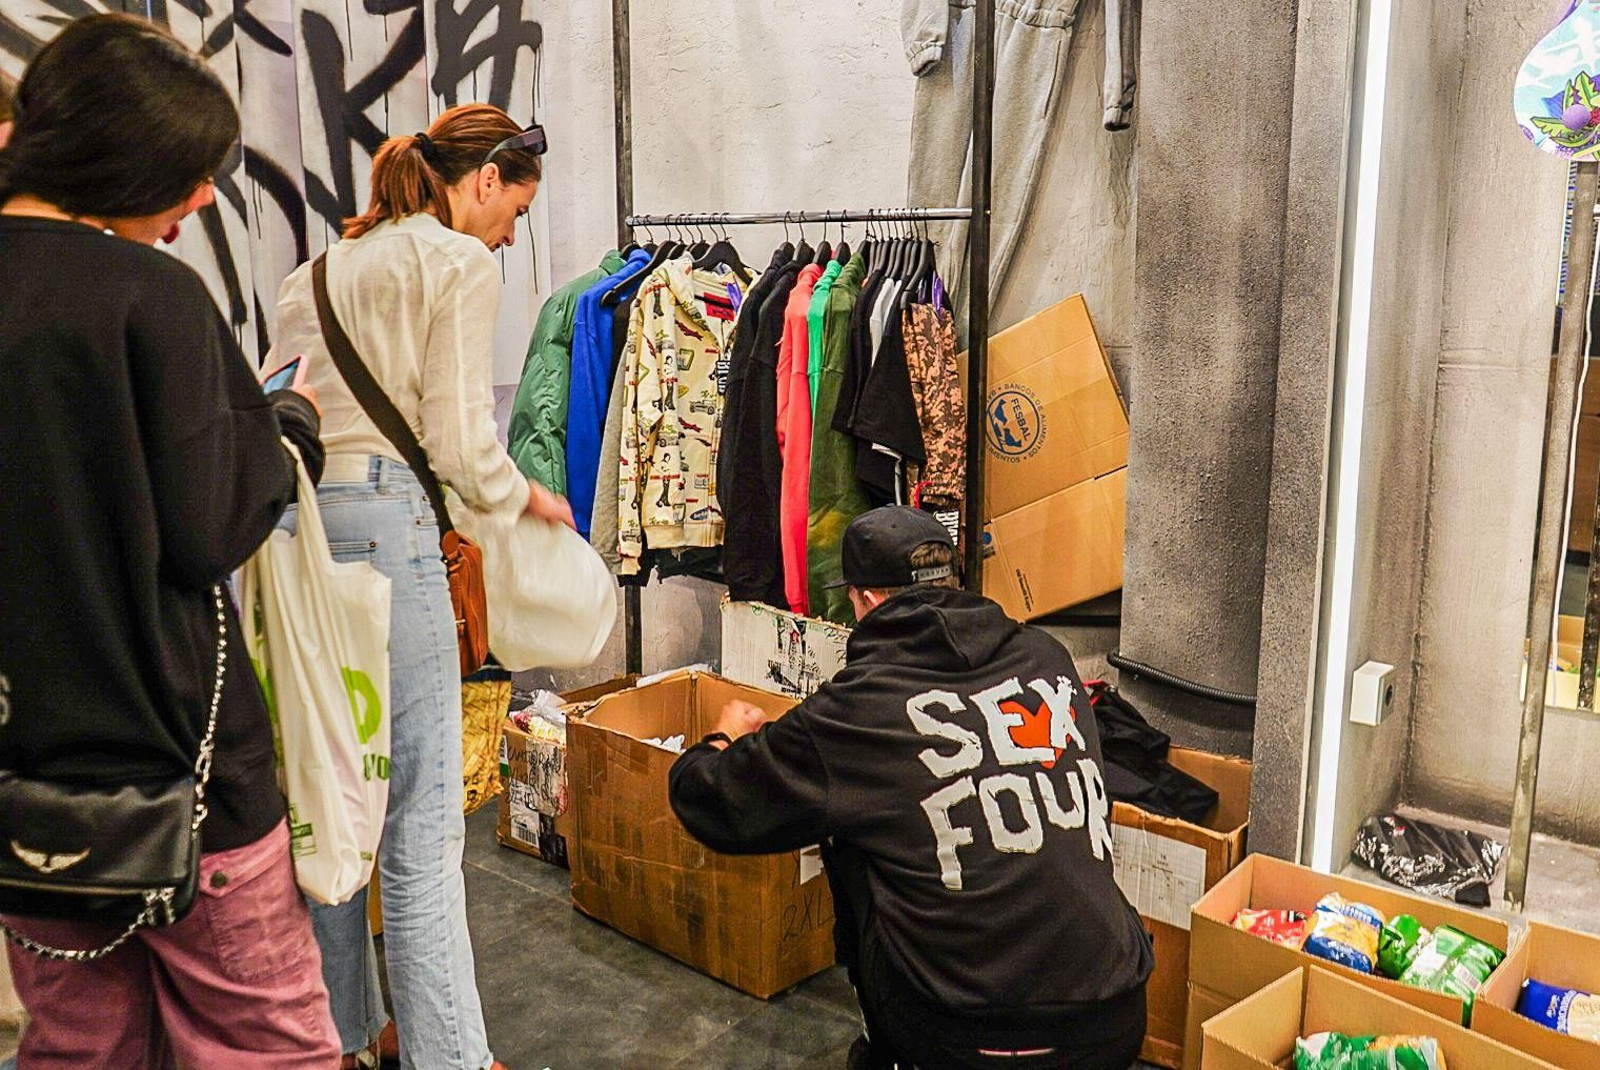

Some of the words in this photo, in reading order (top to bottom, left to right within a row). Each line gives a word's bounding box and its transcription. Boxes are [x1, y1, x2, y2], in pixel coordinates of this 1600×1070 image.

[1004, 383, 1036, 399] BANCOS
[1034, 399, 1044, 411] DE
[1010, 397, 1031, 442] FESBAL
[1028, 413, 1047, 458] ALIMENTOS
[906, 675, 1086, 780] SEX
[920, 758, 1113, 890] FOUR
[783, 889, 833, 942] 2XL
